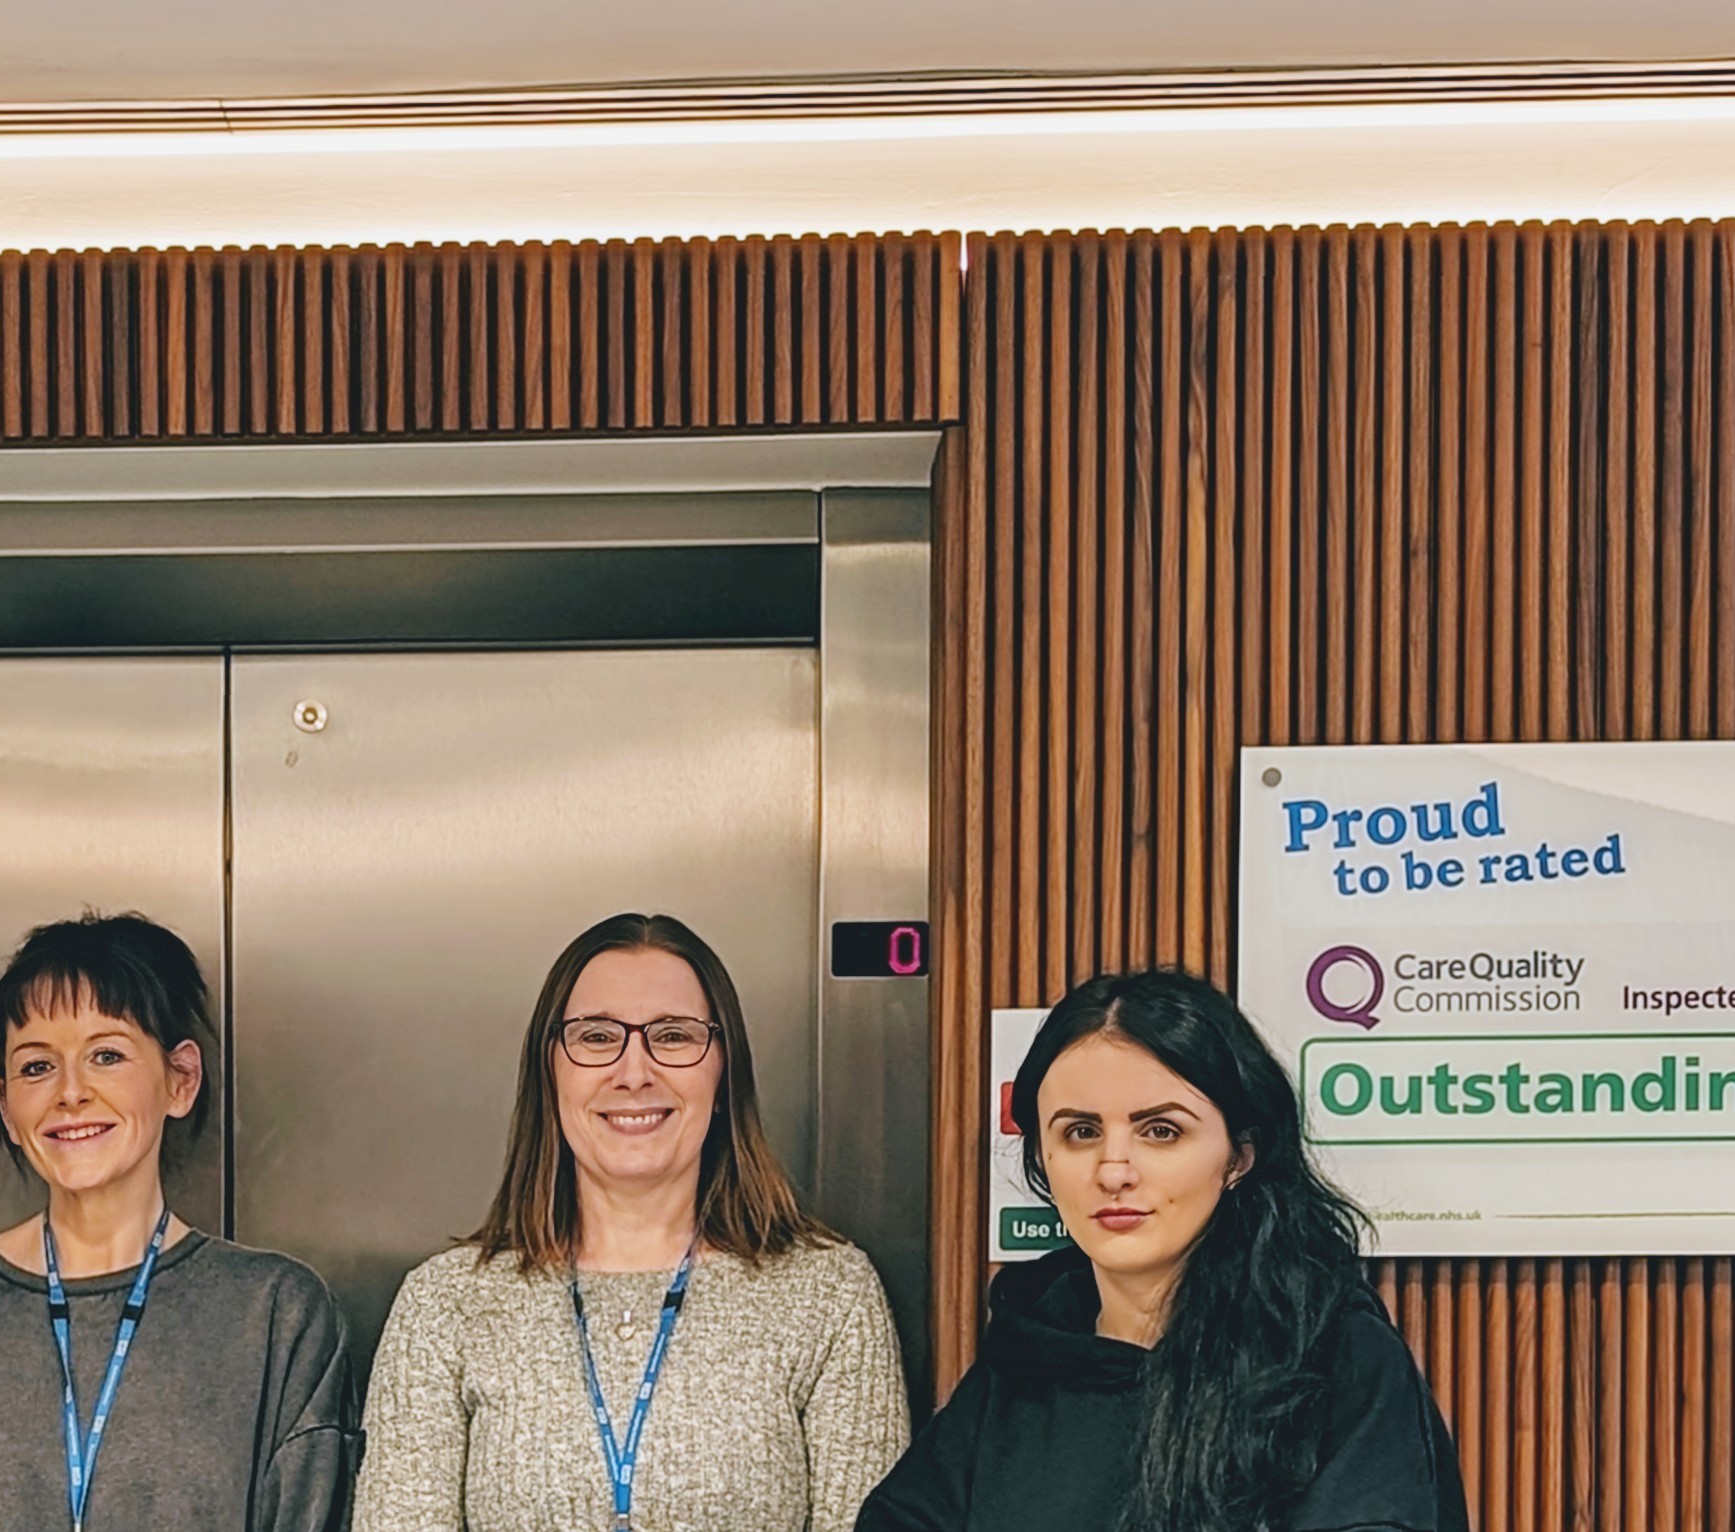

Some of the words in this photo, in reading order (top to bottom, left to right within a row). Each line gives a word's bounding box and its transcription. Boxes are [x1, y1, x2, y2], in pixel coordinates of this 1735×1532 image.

[1282, 781, 1506, 853] Proud
[1333, 859, 1390, 896] to
[1400, 850, 1465, 891] be
[1478, 833, 1627, 885] rated
[889, 927, 921, 974] 0
[1393, 984, 1582, 1013] Commission
[1012, 1220, 1051, 1238] Use
